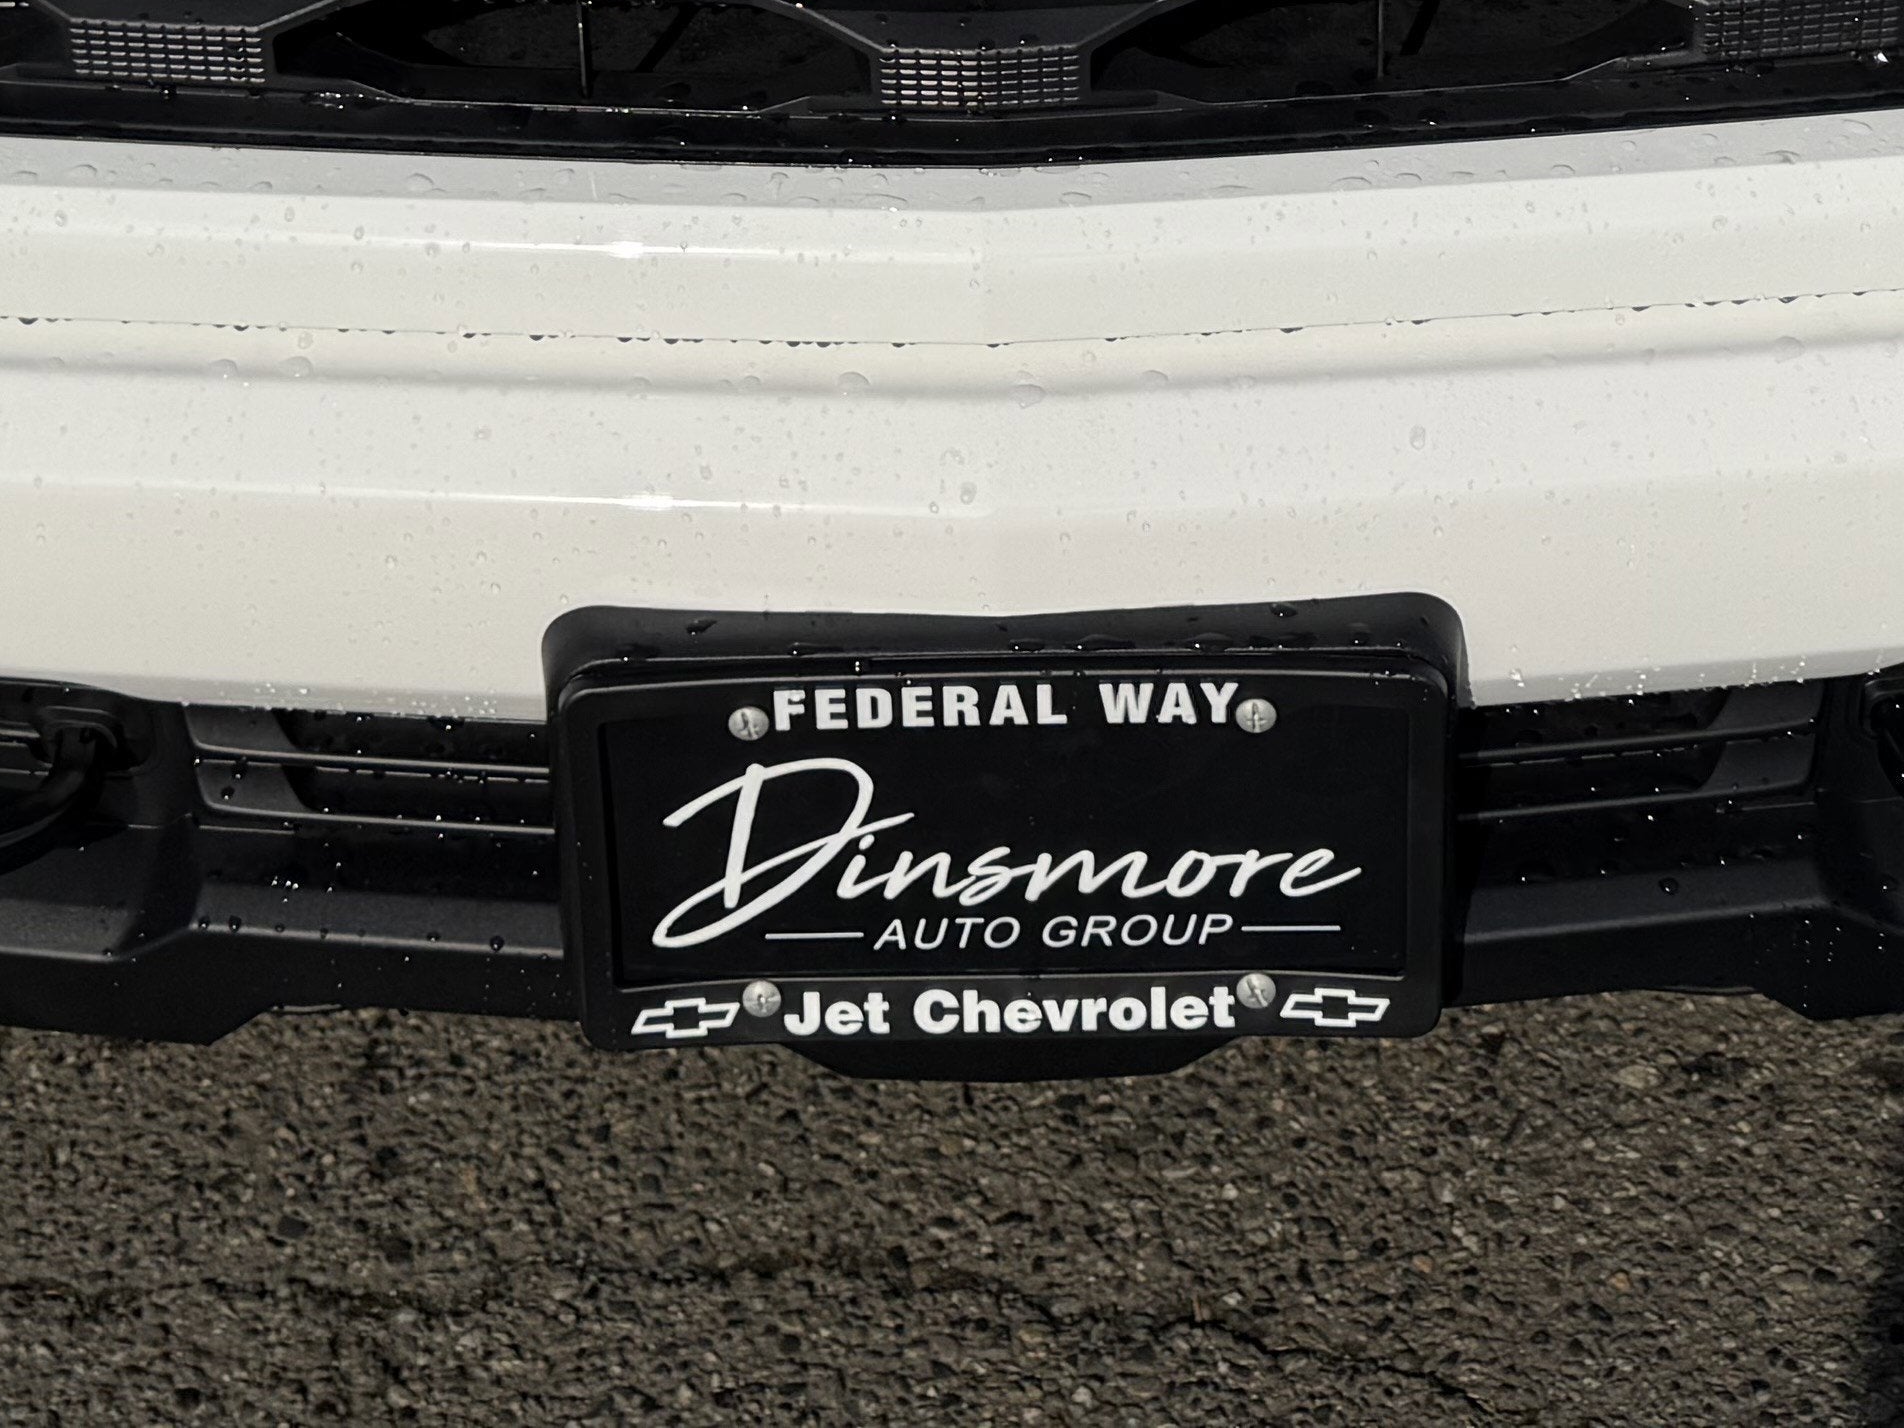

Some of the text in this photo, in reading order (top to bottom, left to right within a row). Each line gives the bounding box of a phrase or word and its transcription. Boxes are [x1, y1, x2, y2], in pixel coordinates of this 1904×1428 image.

[772, 681, 1240, 732] FEDERAL WAY
[651, 757, 1362, 948] Dinsmore
[872, 912, 1234, 951] AUTO GROUP
[783, 985, 1237, 1037] Jet Chevrolet
